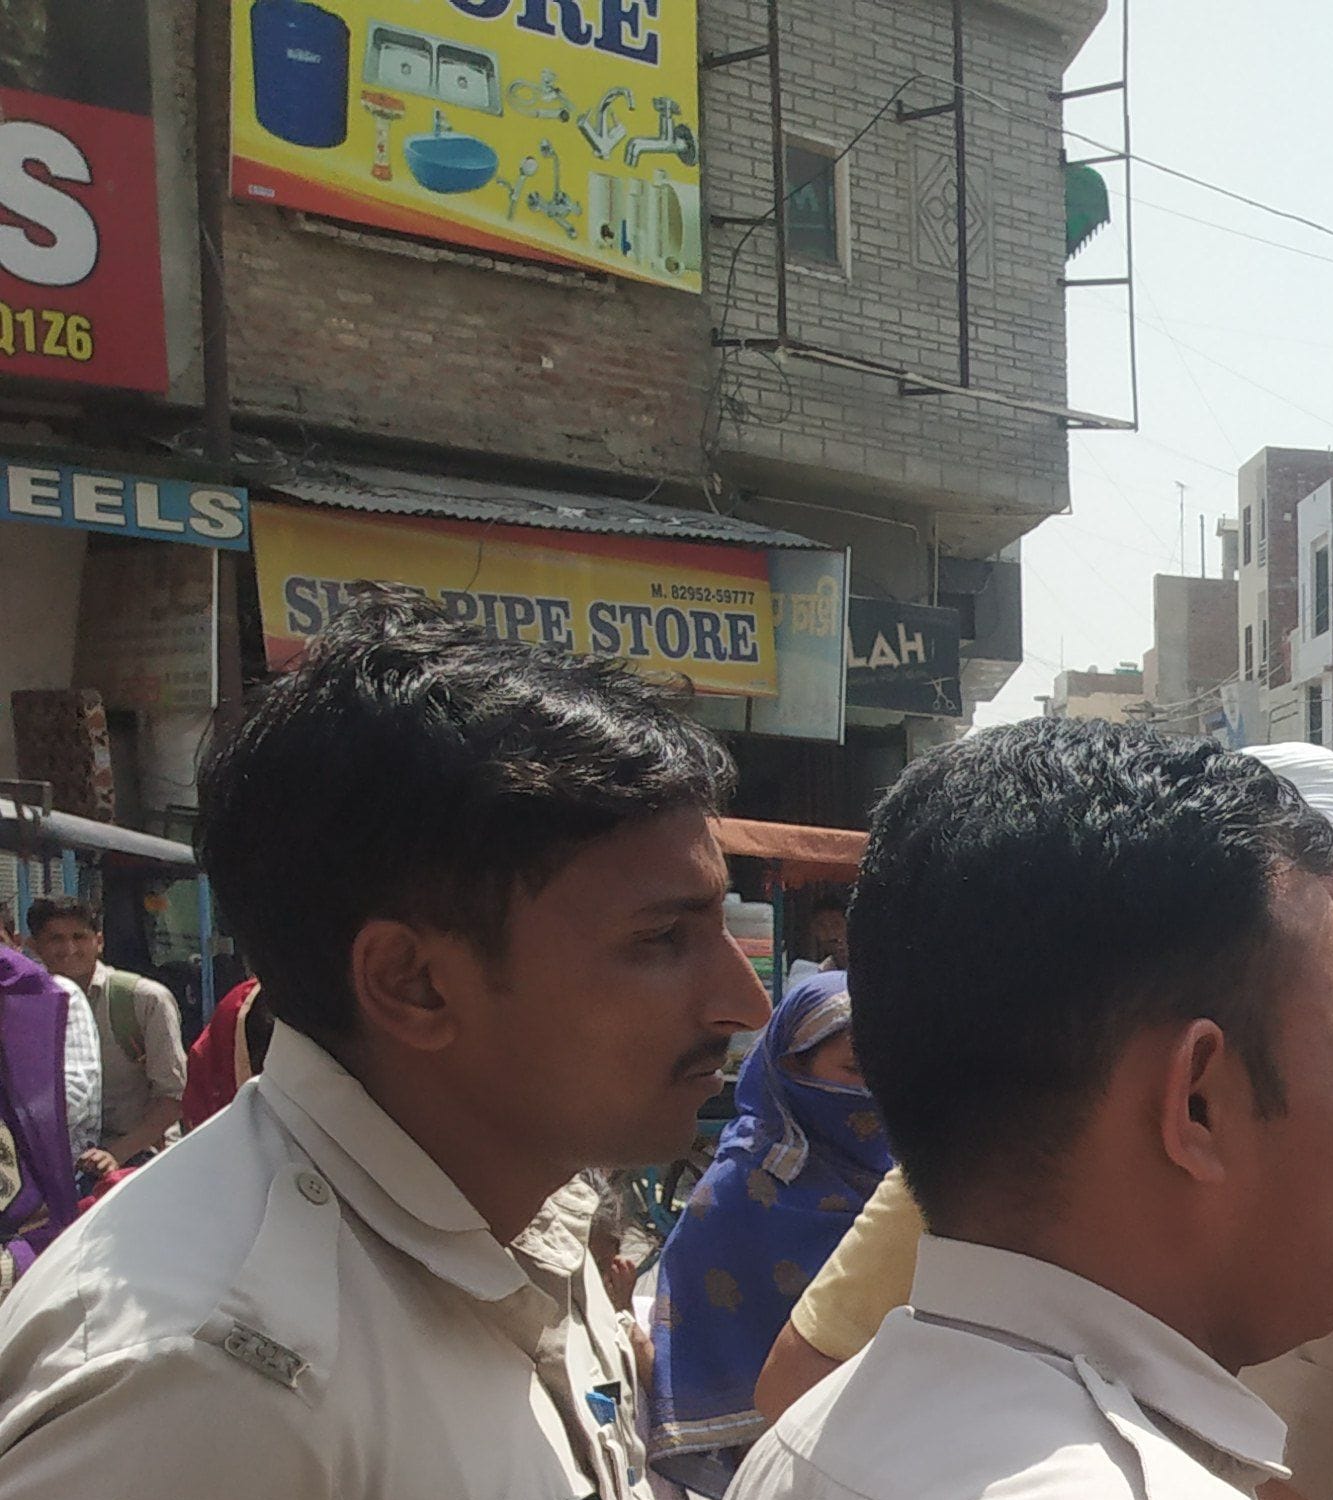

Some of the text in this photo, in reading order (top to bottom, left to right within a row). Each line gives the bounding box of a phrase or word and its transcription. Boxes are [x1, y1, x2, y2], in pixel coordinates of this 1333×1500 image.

[7, 465, 244, 538] EELS
[440, 590, 573, 651] PIPE
[588, 600, 760, 663] STORE
[671, 584, 755, 605] 82952-59777
